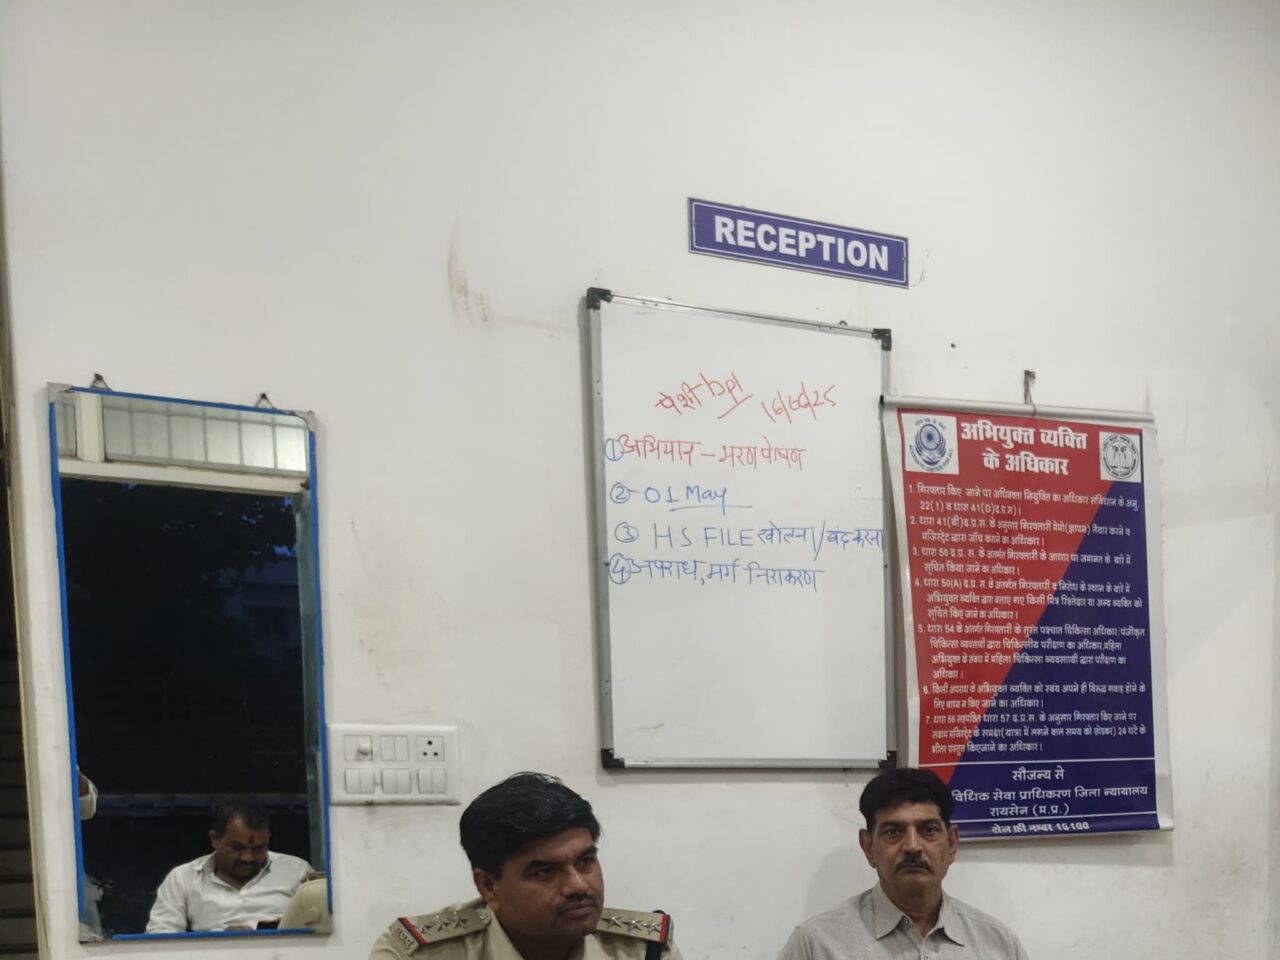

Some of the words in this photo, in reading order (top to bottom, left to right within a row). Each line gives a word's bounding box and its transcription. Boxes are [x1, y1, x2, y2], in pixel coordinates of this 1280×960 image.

[714, 215, 889, 272] RECEPTION
[960, 419, 1035, 449] अभियुक्त
[1039, 426, 1088, 450] व्यक्ति
[982, 447, 1000, 470] के
[1005, 451, 1069, 475] अधिकार
[686, 485, 727, 515] May
[965, 485, 980, 497] जाने
[983, 489, 991, 498] पर
[703, 527, 754, 548] FILE
[1000, 714, 1010, 722] 57
[1039, 711, 1046, 722] के
[1114, 710, 1126, 721] जाने
[1128, 712, 1136, 721] पर
[1012, 766, 1051, 781] सौजन्य
[1055, 765, 1065, 780] से
[993, 788, 1016, 801] सेवा
[1019, 787, 1071, 800] प्राधिकरण
[1075, 785, 1101, 798] जिला
[1104, 785, 1149, 797] न्यायालय
[990, 803, 1028, 817] रायसेन
